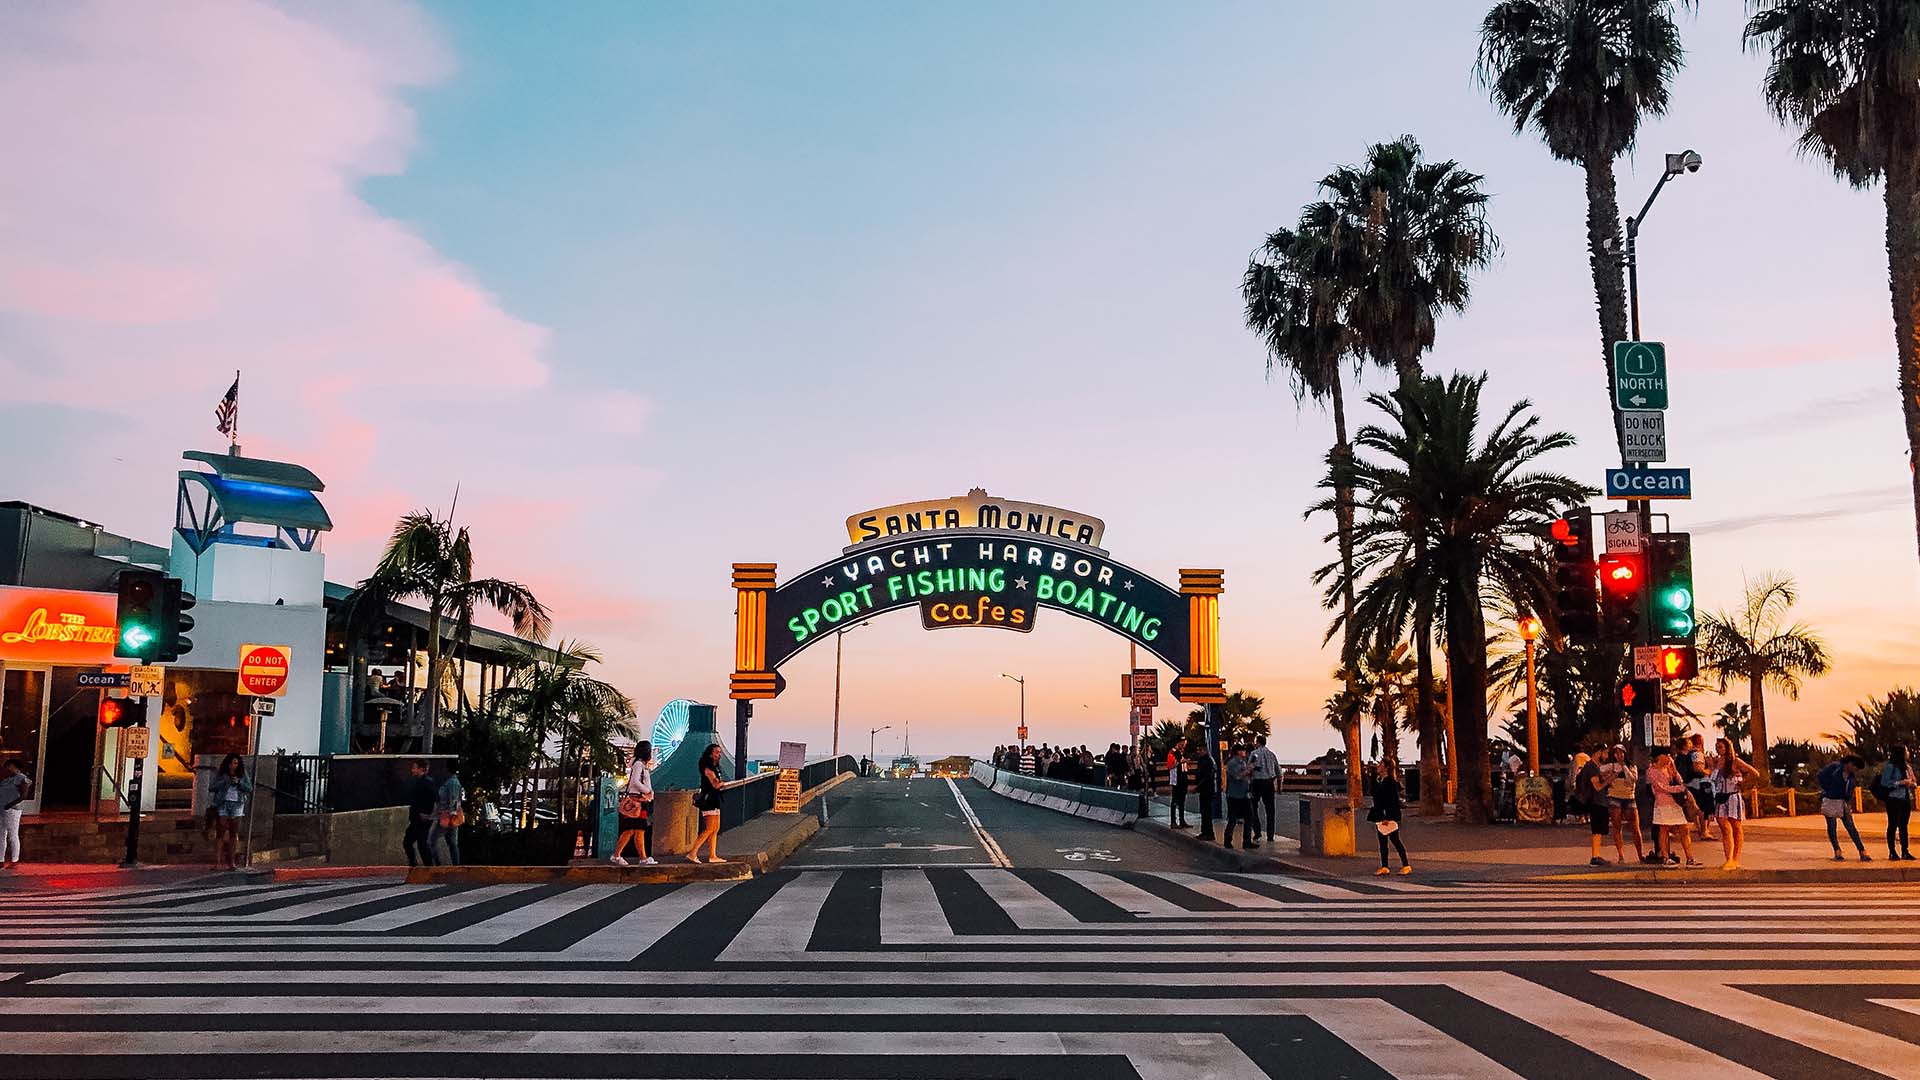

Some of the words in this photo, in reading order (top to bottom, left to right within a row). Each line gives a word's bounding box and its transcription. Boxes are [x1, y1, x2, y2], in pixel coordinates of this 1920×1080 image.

[1637, 354, 1643, 370] 1
[1619, 378, 1664, 390] NORTH
[1625, 417, 1640, 429] DO
[1642, 417, 1661, 429] NOT
[1626, 434, 1662, 446] BLOCK
[1626, 449, 1664, 457] INTERSECTION
[1612, 472, 1684, 490] Ocean
[858, 508, 960, 542] SANTA
[977, 504, 1094, 546] MONICA
[1608, 539, 1637, 548] SIGNAL
[842, 543, 953, 581] YACHT
[979, 543, 1114, 586] HARBOR
[787, 583, 873, 642] SPORT
[887, 567, 1006, 602] FISHING
[1036, 574, 1162, 641] BOATING
[60, 612, 86, 625] THE
[249, 656, 261, 664] DO
[265, 656, 283, 665] NOT
[1636, 664, 1646, 675] OK
[79, 674, 115, 684] Ocean
[249, 677, 277, 686] ENTER
[131, 681, 144, 693] OK
